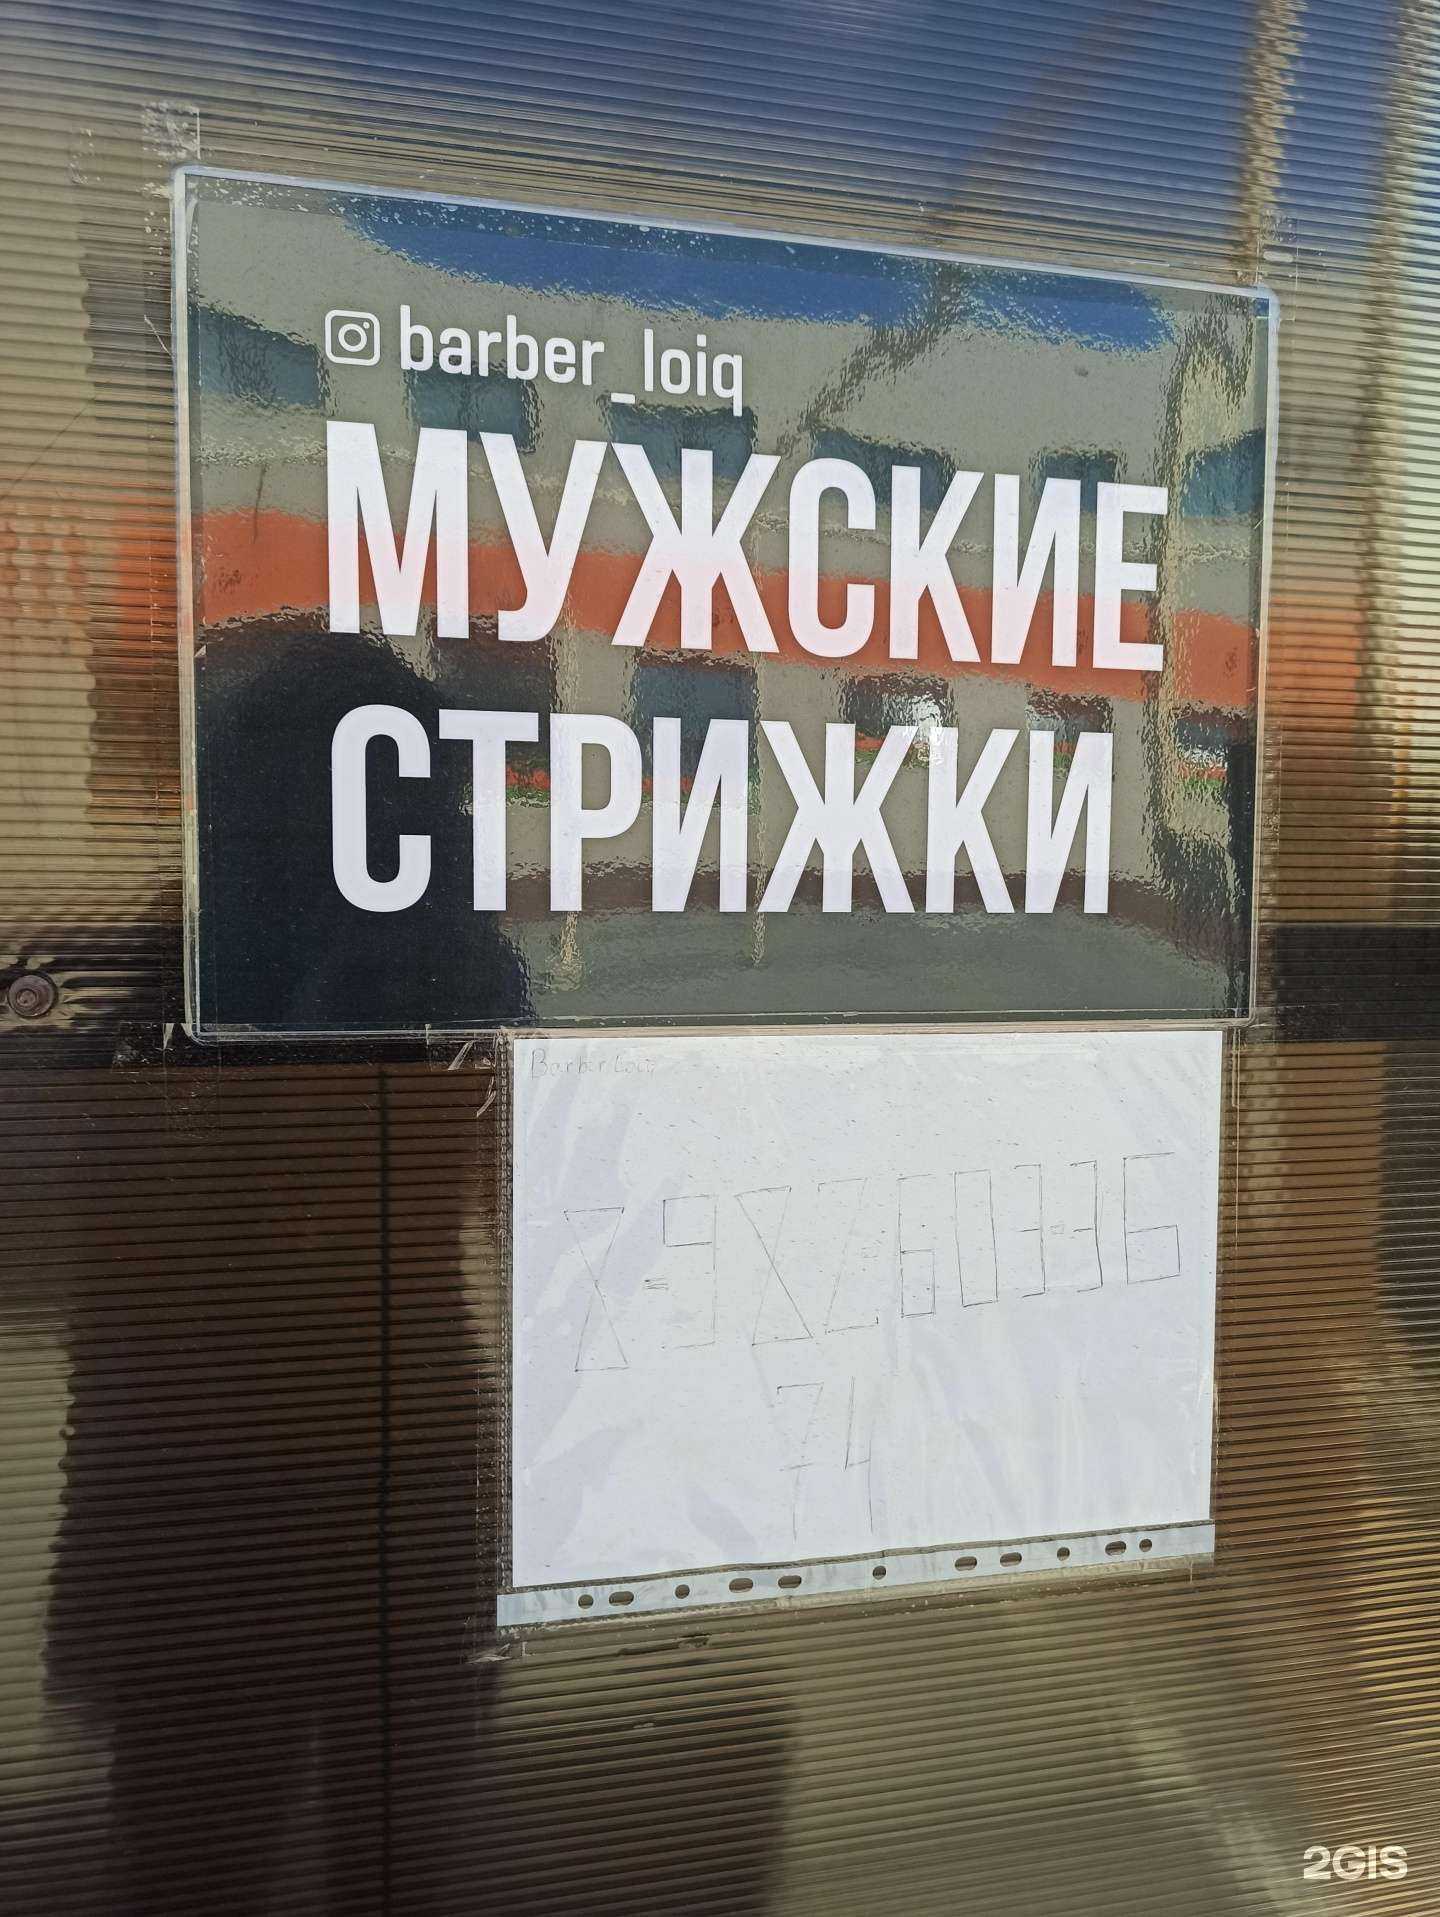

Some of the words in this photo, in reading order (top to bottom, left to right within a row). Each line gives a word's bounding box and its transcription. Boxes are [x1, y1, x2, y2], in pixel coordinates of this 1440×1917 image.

[400, 305, 745, 417] barber_loiq
[325, 420, 1168, 672] МУЖСКИЕ
[330, 704, 1114, 915] СТРИЖКИ
